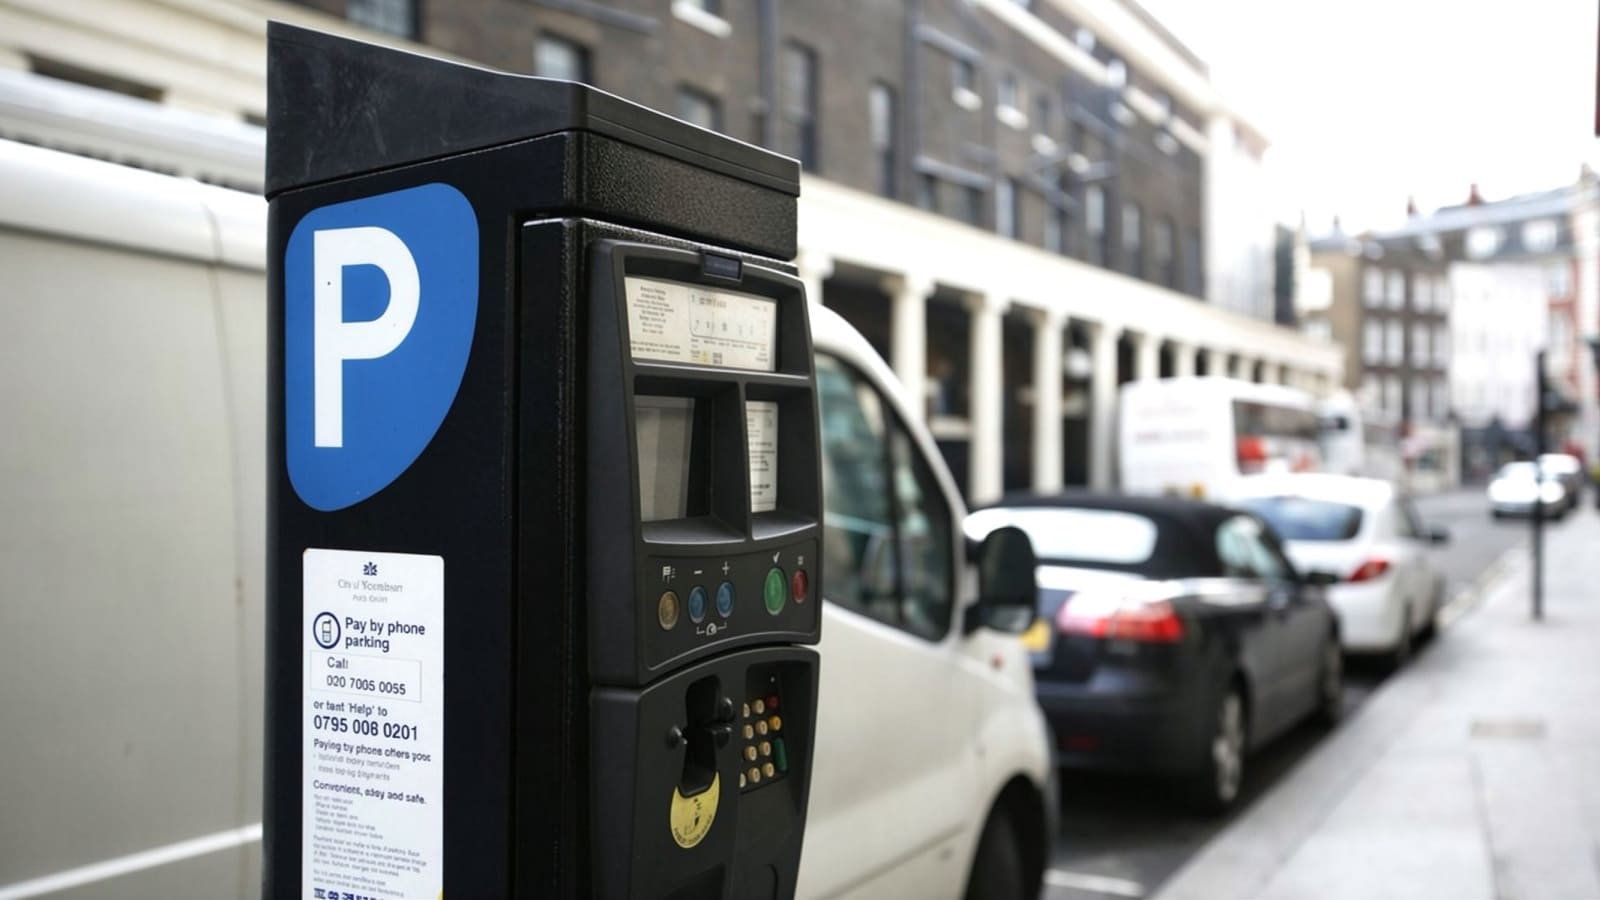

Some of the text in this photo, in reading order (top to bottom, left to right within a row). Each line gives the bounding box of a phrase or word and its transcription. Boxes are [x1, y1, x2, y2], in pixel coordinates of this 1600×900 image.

[314, 226, 420, 448] P
[345, 617, 426, 636] Pay by phone
[345, 636, 390, 653] parking
[326, 675, 346, 688] 020
[313, 715, 348, 733] 0795
[383, 722, 418, 741] 0201
